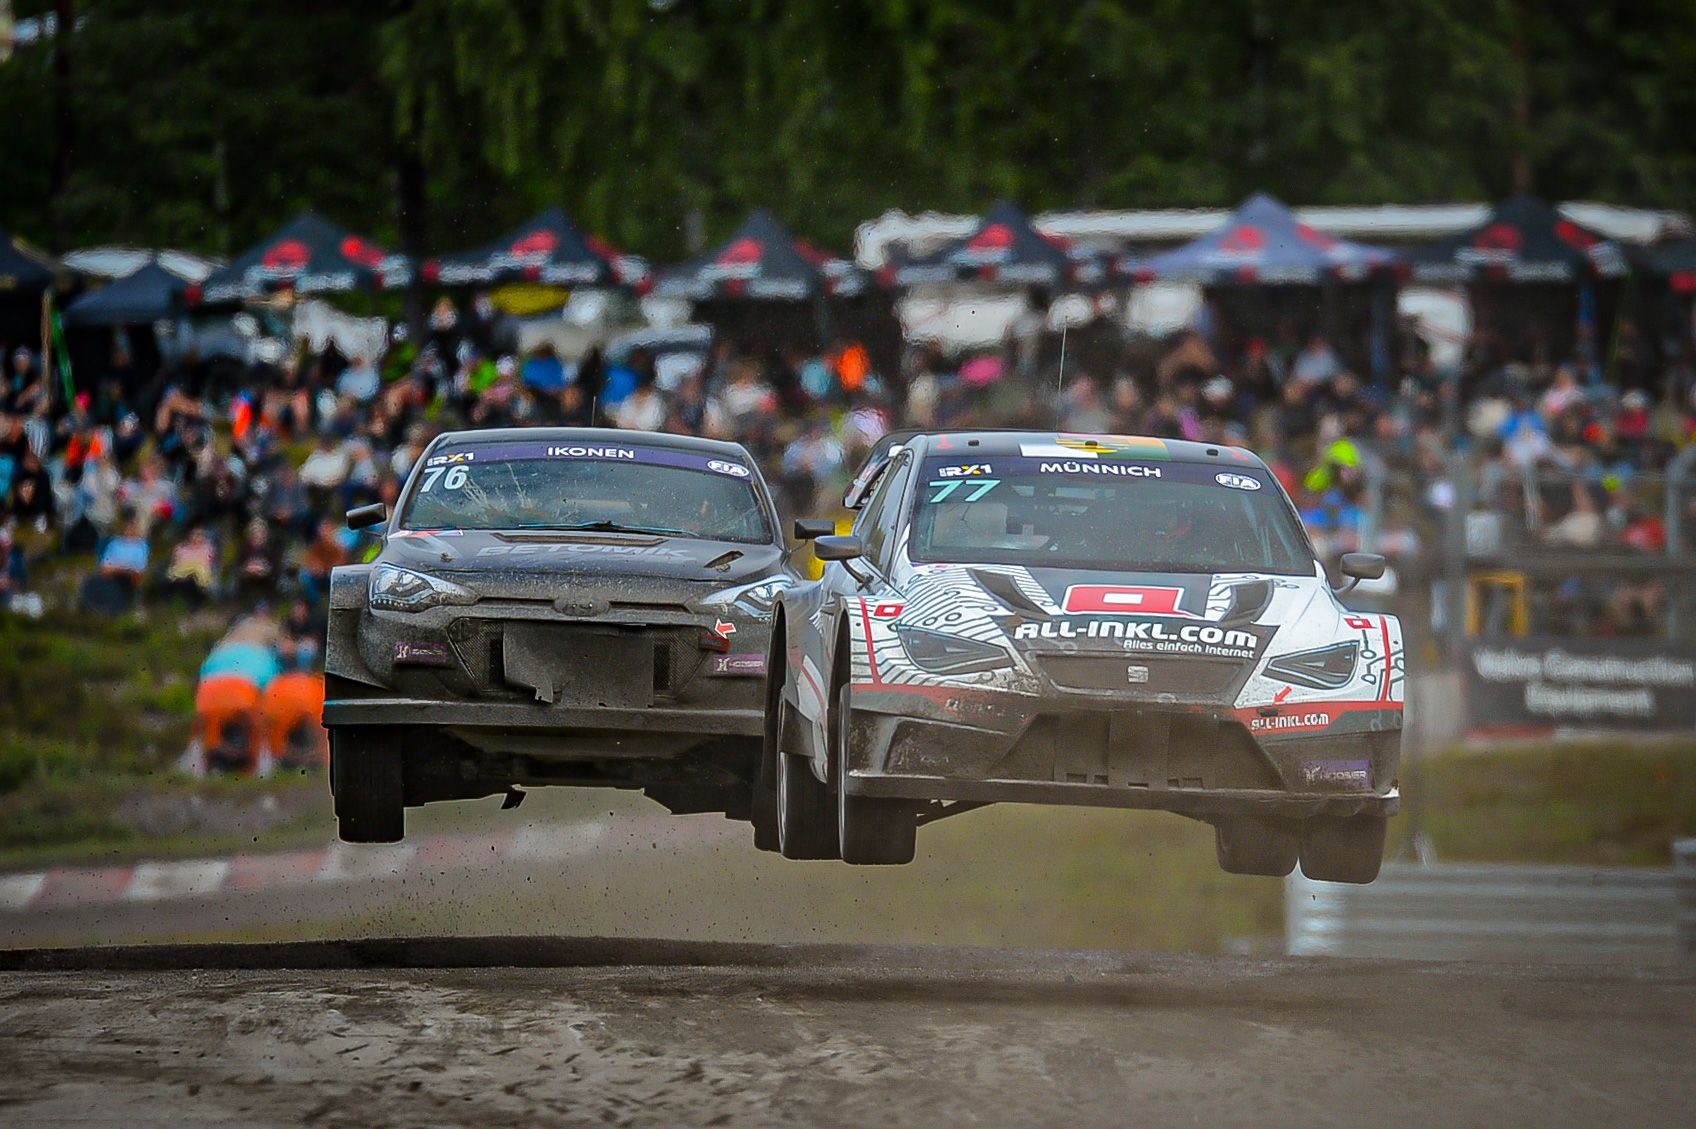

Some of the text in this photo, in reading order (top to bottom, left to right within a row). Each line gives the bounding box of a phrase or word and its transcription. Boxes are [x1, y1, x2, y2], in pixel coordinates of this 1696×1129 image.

[547, 446, 635, 460] IKONEN
[708, 460, 749, 477] FIA
[1040, 461, 1162, 478] MÜNNICH
[420, 465, 470, 493] 76
[1216, 473, 1260, 490] FIA
[929, 479, 1001, 503] 77
[1123, 639, 1154, 651] Alles
[1156, 641, 1202, 653] einfach
